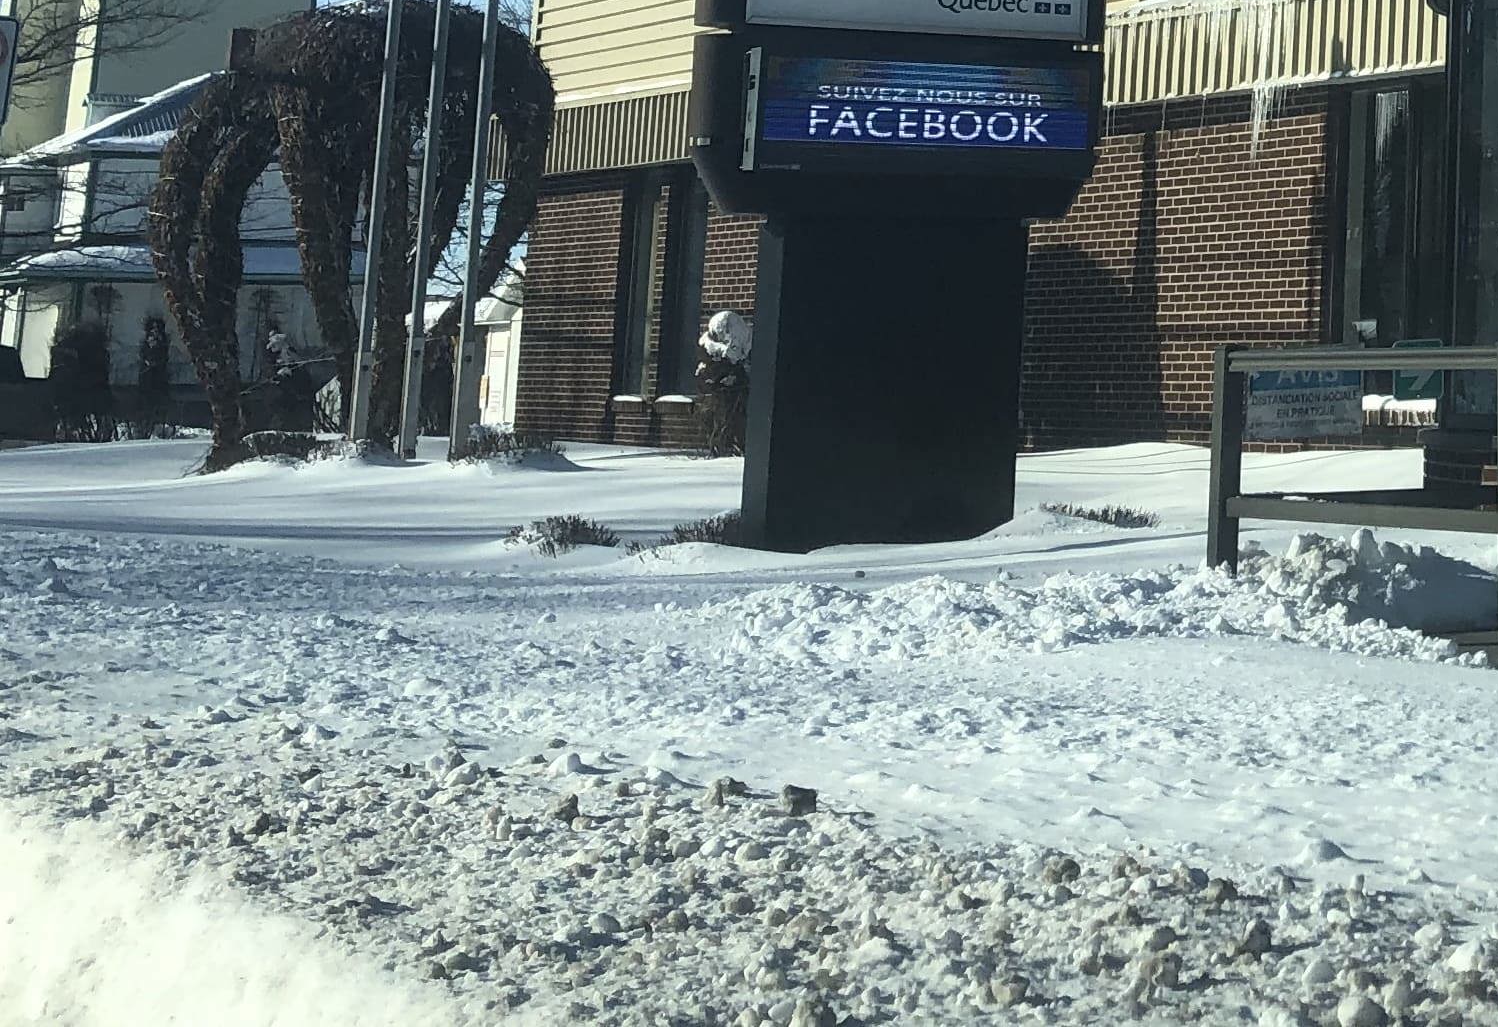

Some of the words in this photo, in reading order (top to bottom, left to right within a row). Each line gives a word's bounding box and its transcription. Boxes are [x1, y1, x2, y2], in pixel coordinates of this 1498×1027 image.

[818, 85, 905, 101] SUIVEZ
[917, 89, 987, 104] NOUS
[994, 92, 1041, 106] SUR
[808, 105, 1049, 143] FACEBOOK
[1251, 392, 1320, 406] DISTANCIATION
